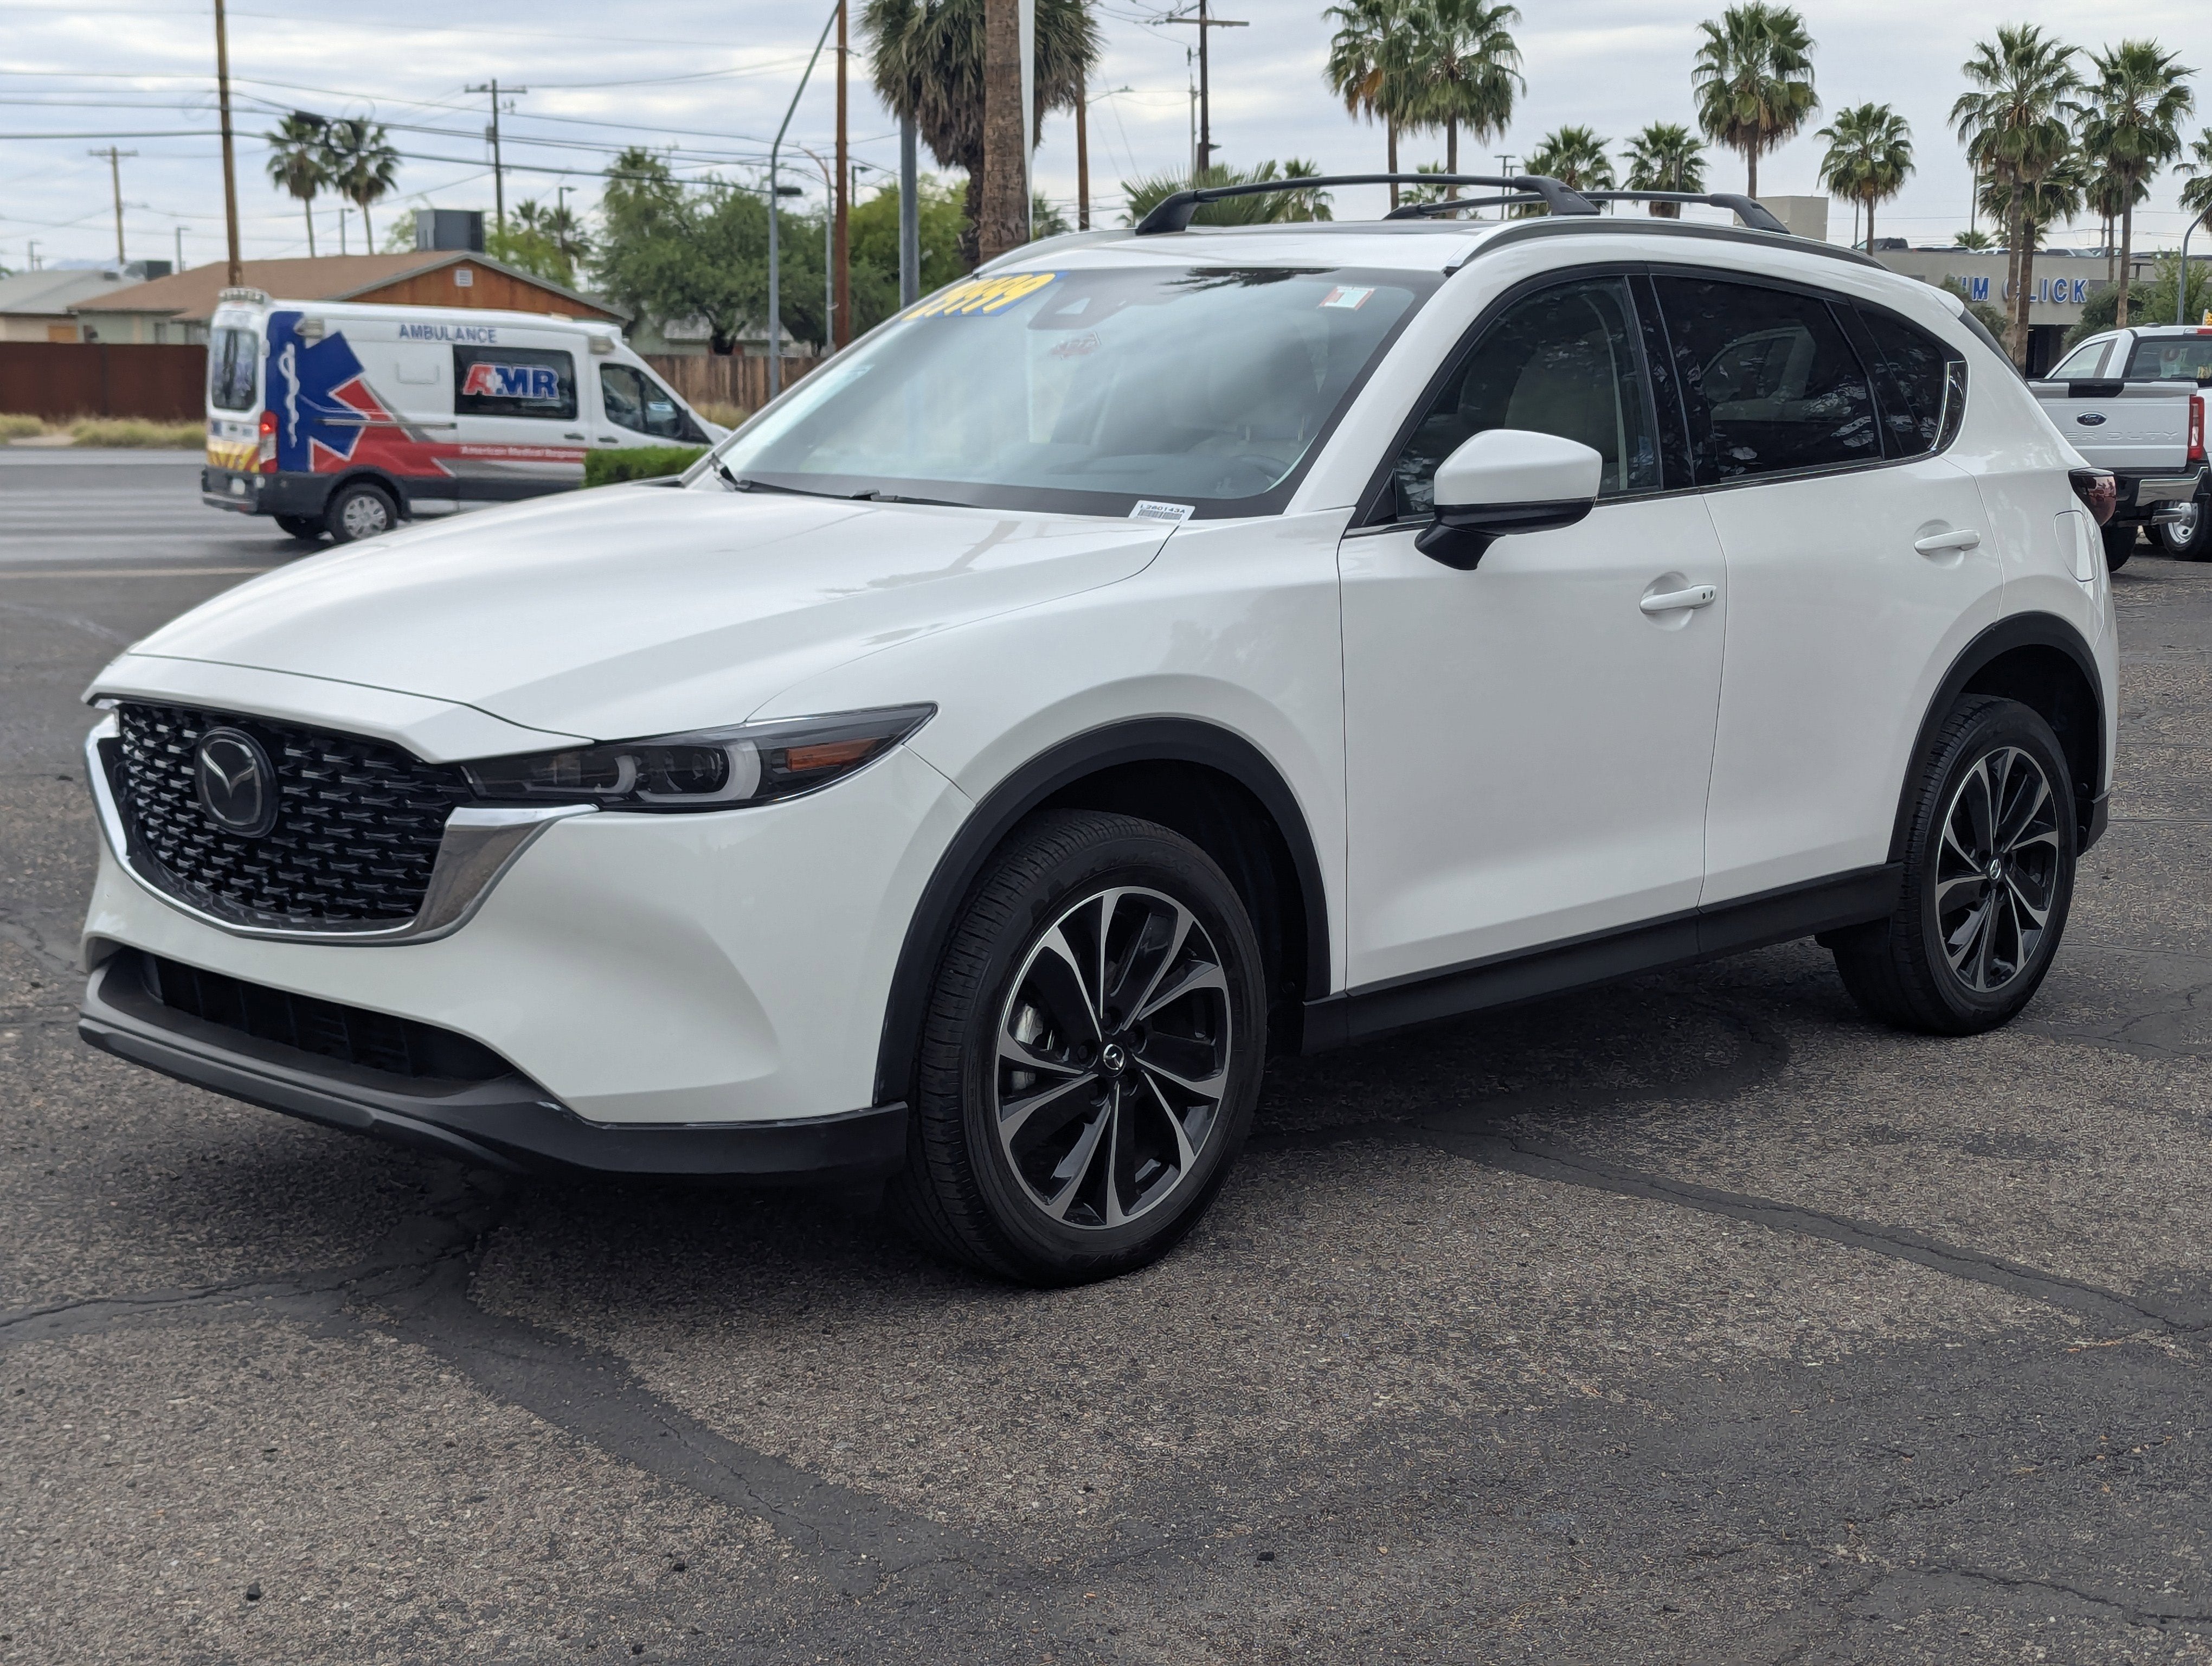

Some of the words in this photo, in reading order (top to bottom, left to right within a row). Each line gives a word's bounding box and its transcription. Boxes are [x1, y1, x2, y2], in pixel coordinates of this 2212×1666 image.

[1952, 276, 1989, 302] IM
[399, 324, 498, 343] AMBULANCE
[462, 363, 560, 399] AMR
[2106, 432, 2178, 440] DUTY
[507, 447, 544, 457] Medical
